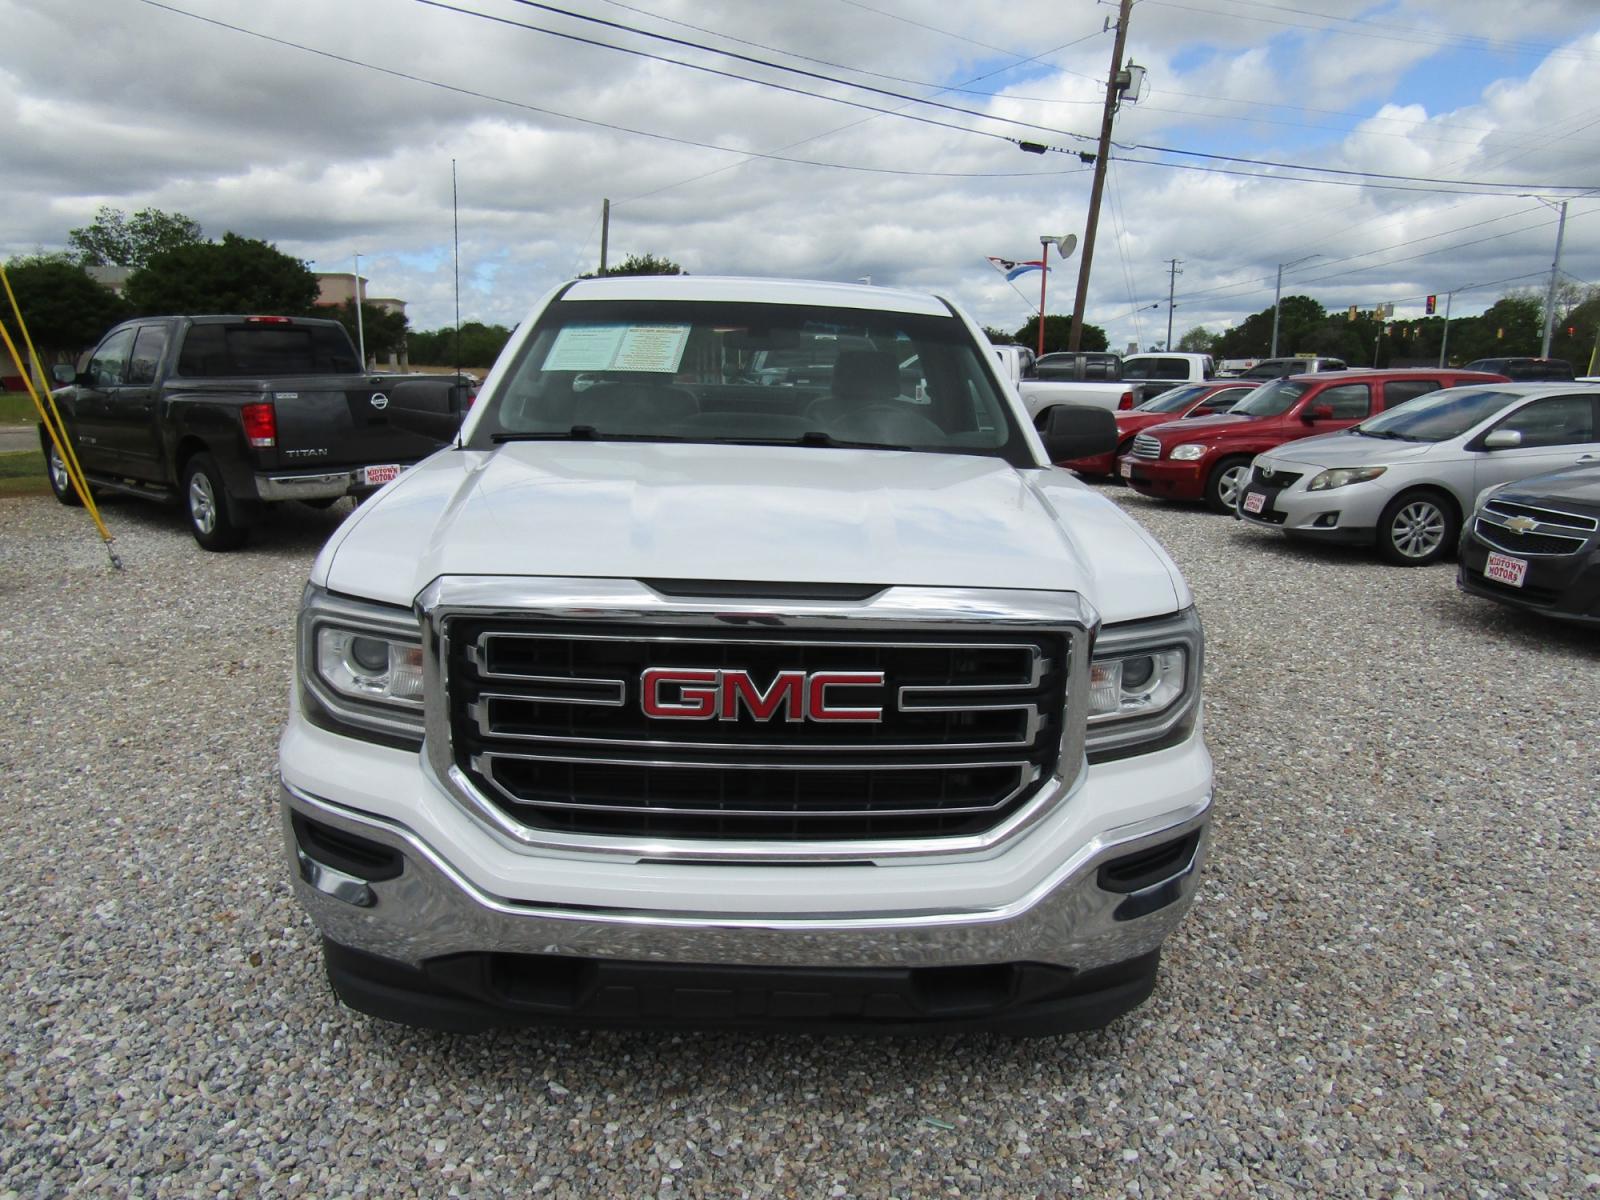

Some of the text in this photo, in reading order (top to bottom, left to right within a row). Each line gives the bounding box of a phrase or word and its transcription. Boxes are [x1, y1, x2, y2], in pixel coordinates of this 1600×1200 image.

[286, 448, 328, 458] TITAN
[368, 466, 398, 475] MIDTOWN
[1488, 556, 1524, 573] MIDTOWN
[1488, 566, 1519, 582] MOTORS
[640, 667, 885, 722] GMC
